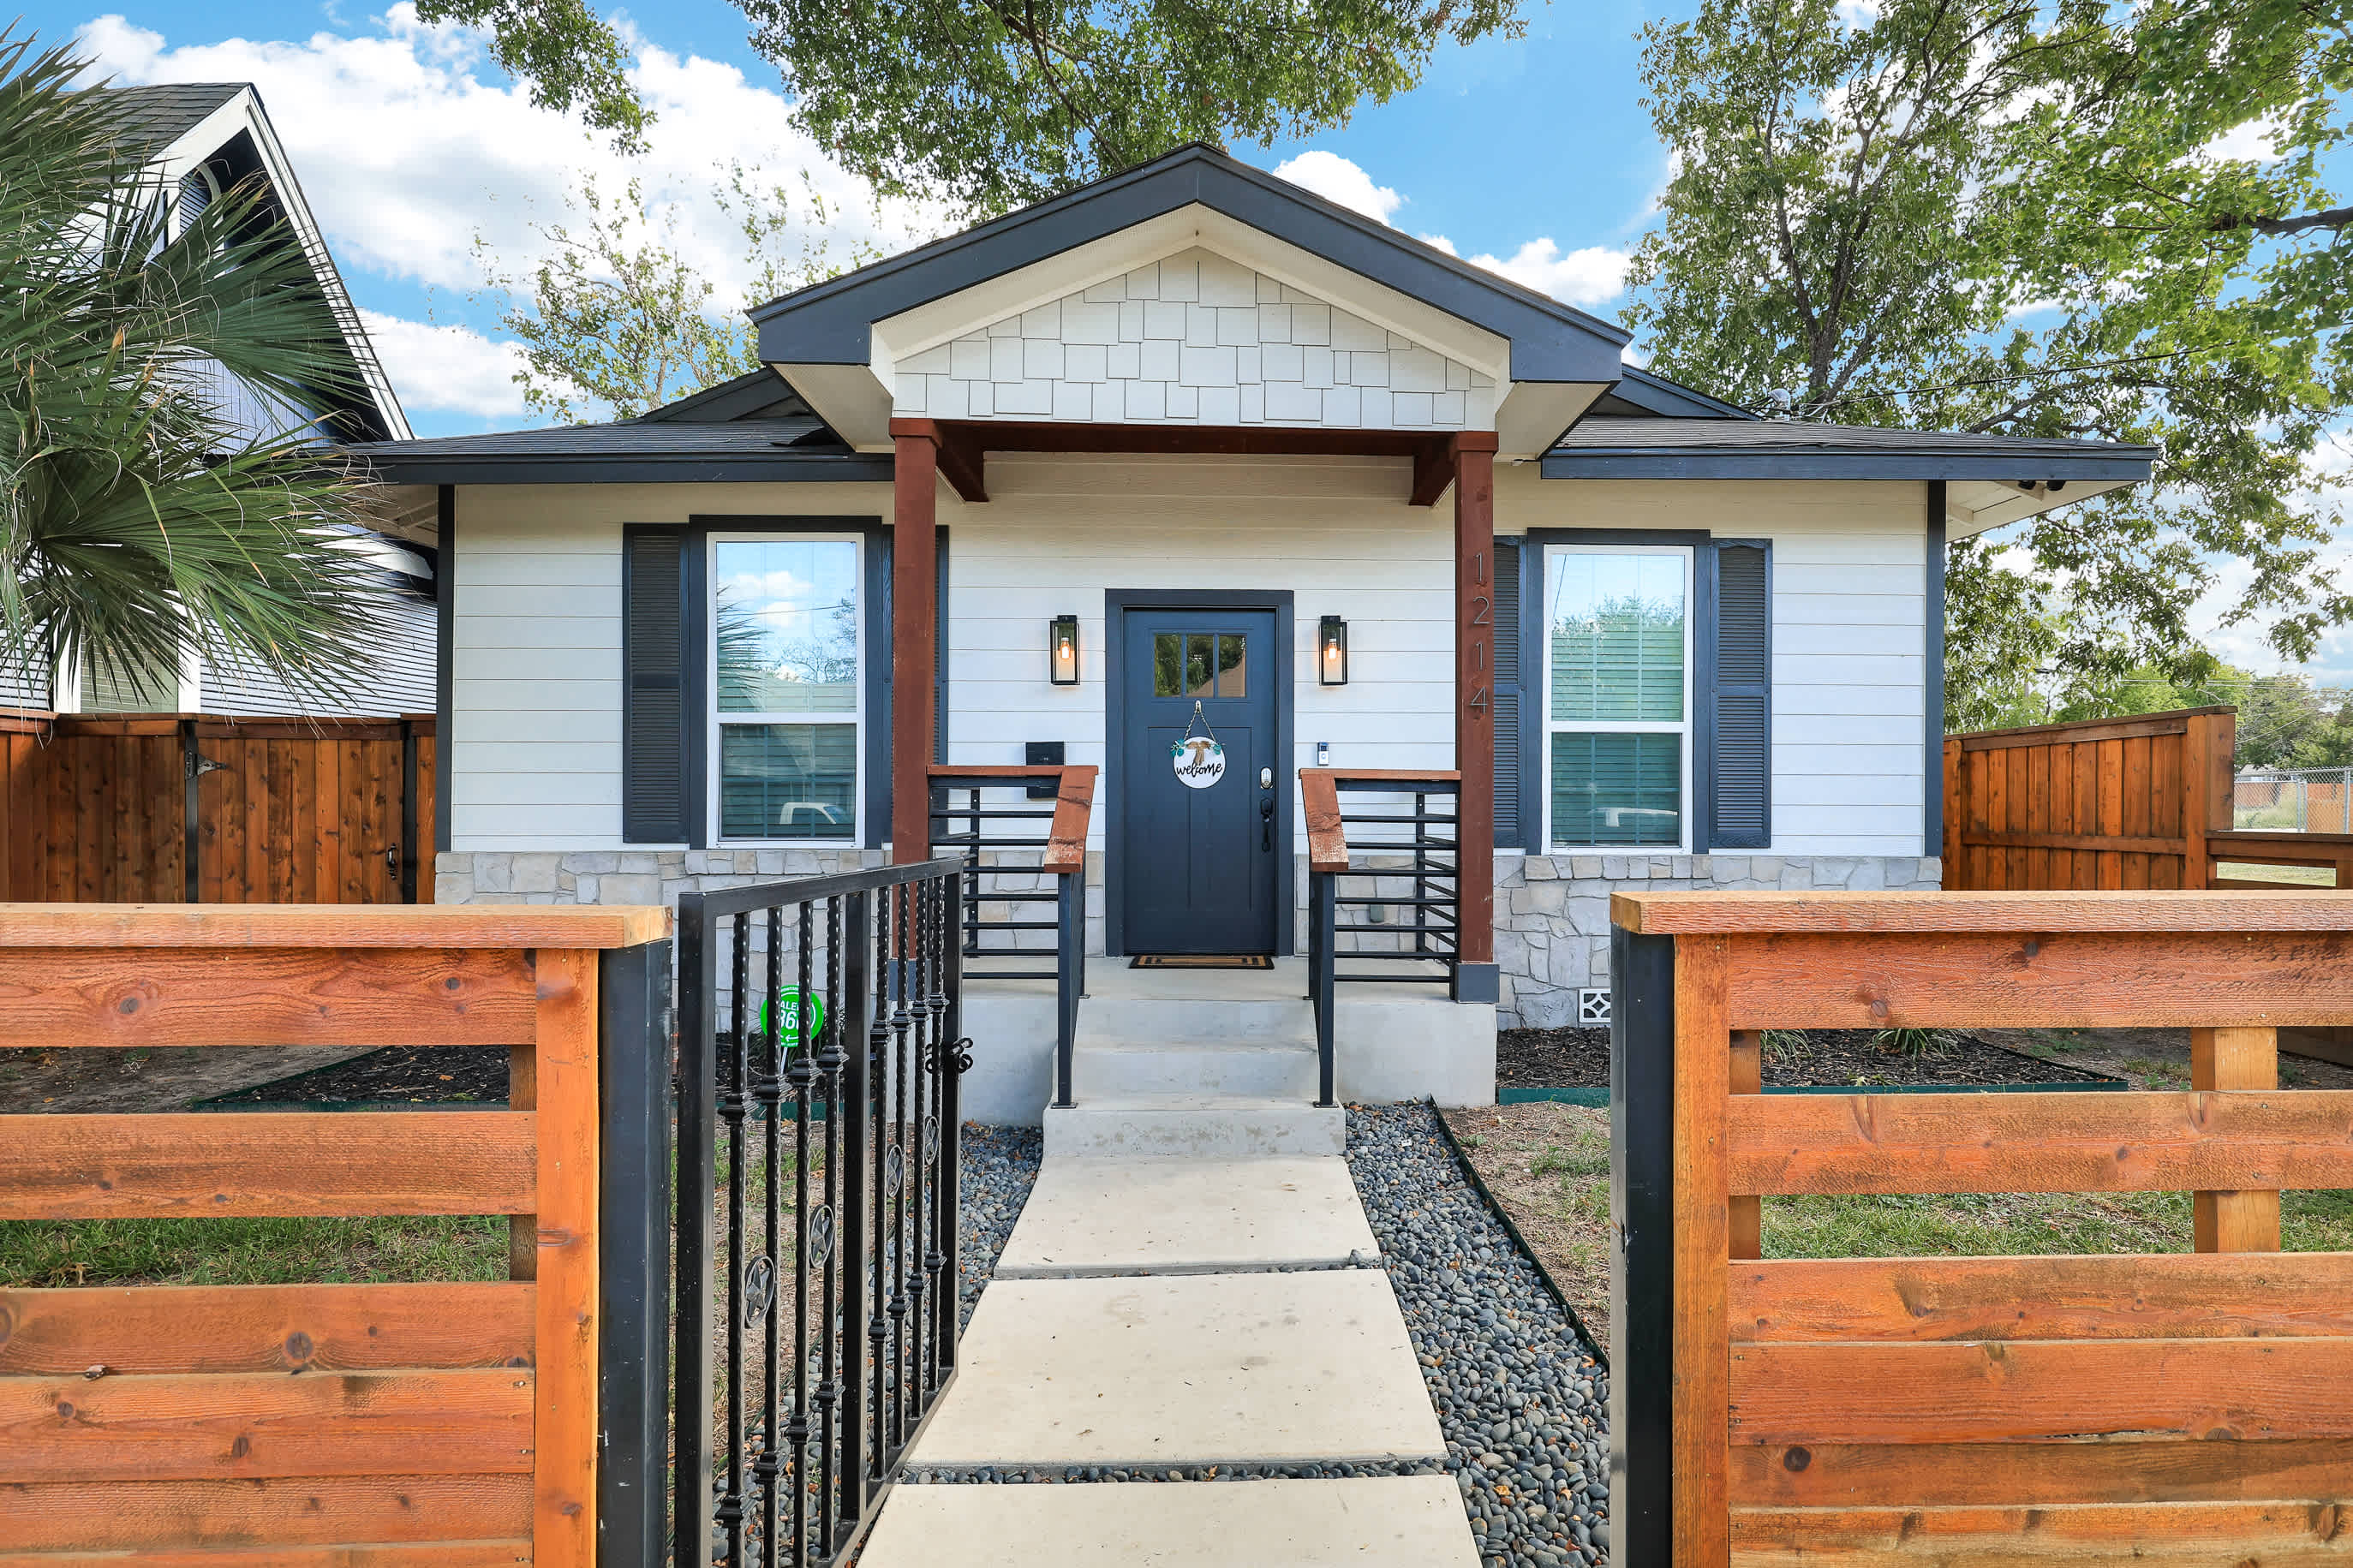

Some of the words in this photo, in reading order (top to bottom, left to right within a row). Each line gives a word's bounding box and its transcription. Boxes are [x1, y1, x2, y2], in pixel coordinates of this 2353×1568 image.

[1469, 551, 1490, 714] 1214
[1176, 761, 1223, 778] welcome
[780, 1000, 799, 1011] ALE
